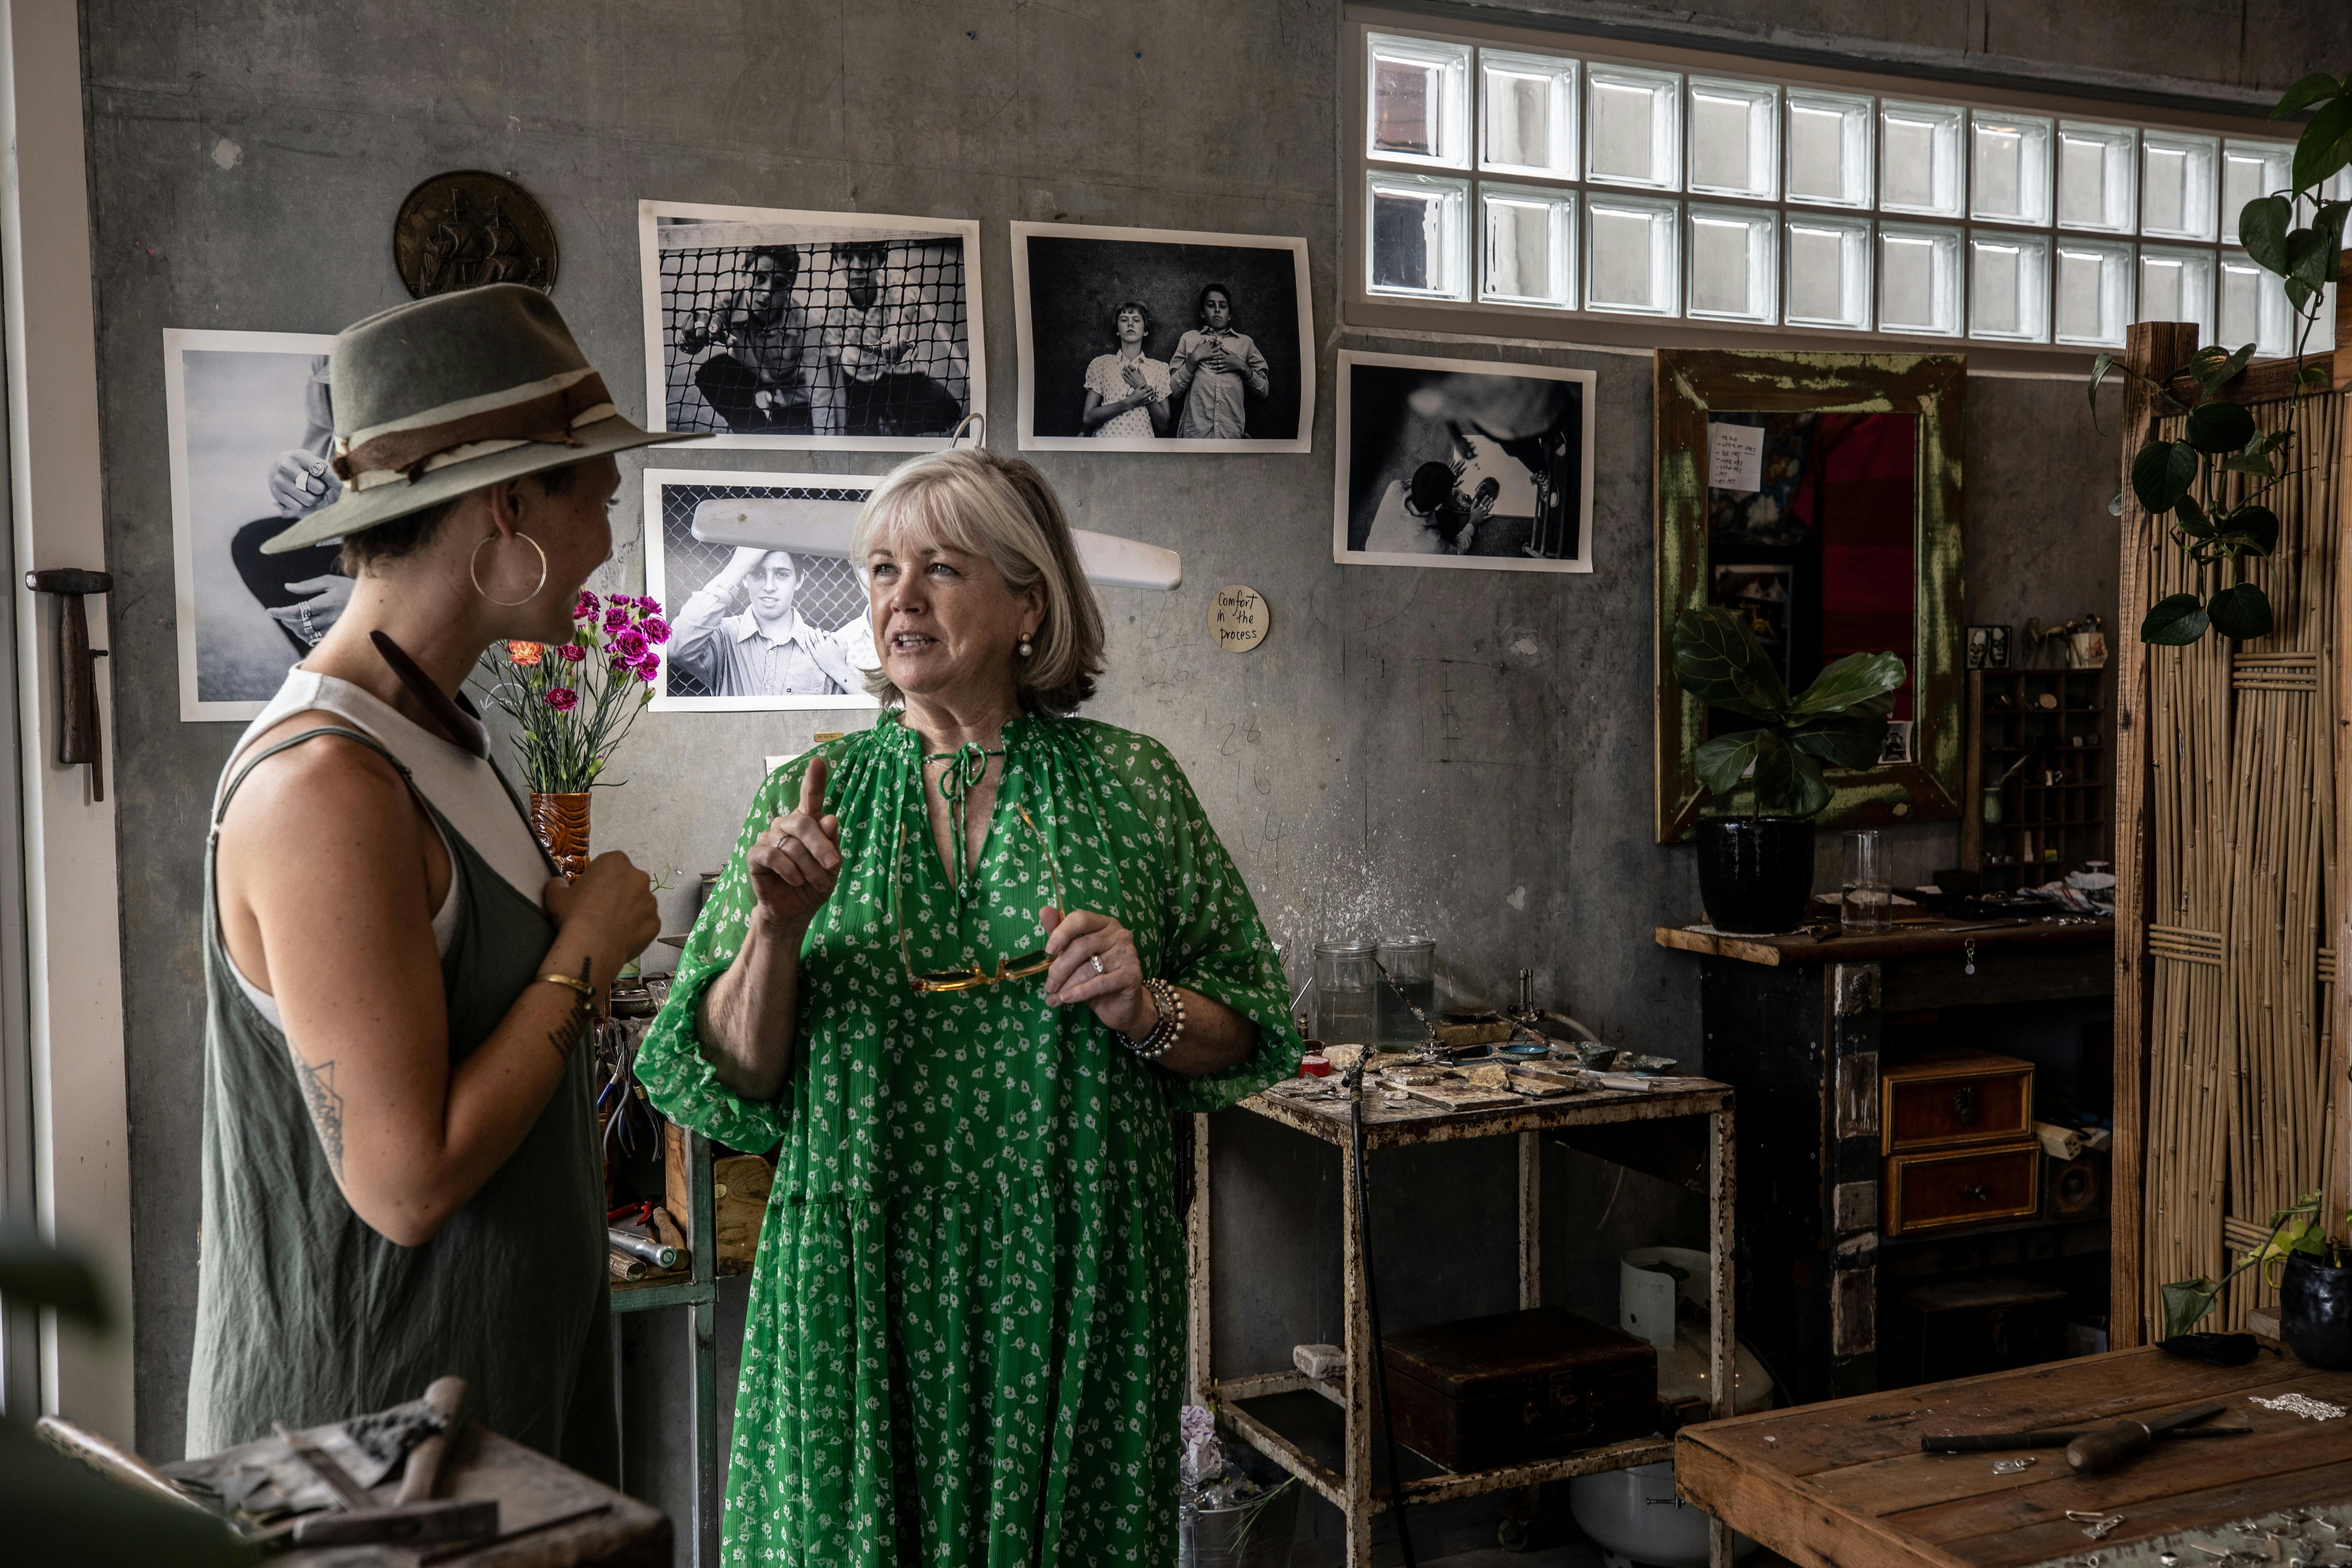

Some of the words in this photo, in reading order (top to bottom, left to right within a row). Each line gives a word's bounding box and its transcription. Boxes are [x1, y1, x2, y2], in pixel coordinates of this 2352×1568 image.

[1218, 590, 1257, 616] Comfort
[1217, 610, 1224, 622] in
[1236, 610, 1254, 624] the
[1220, 627, 1257, 648] process
[1217, 717, 1261, 755] 28
[1237, 761, 1271, 804] 16
